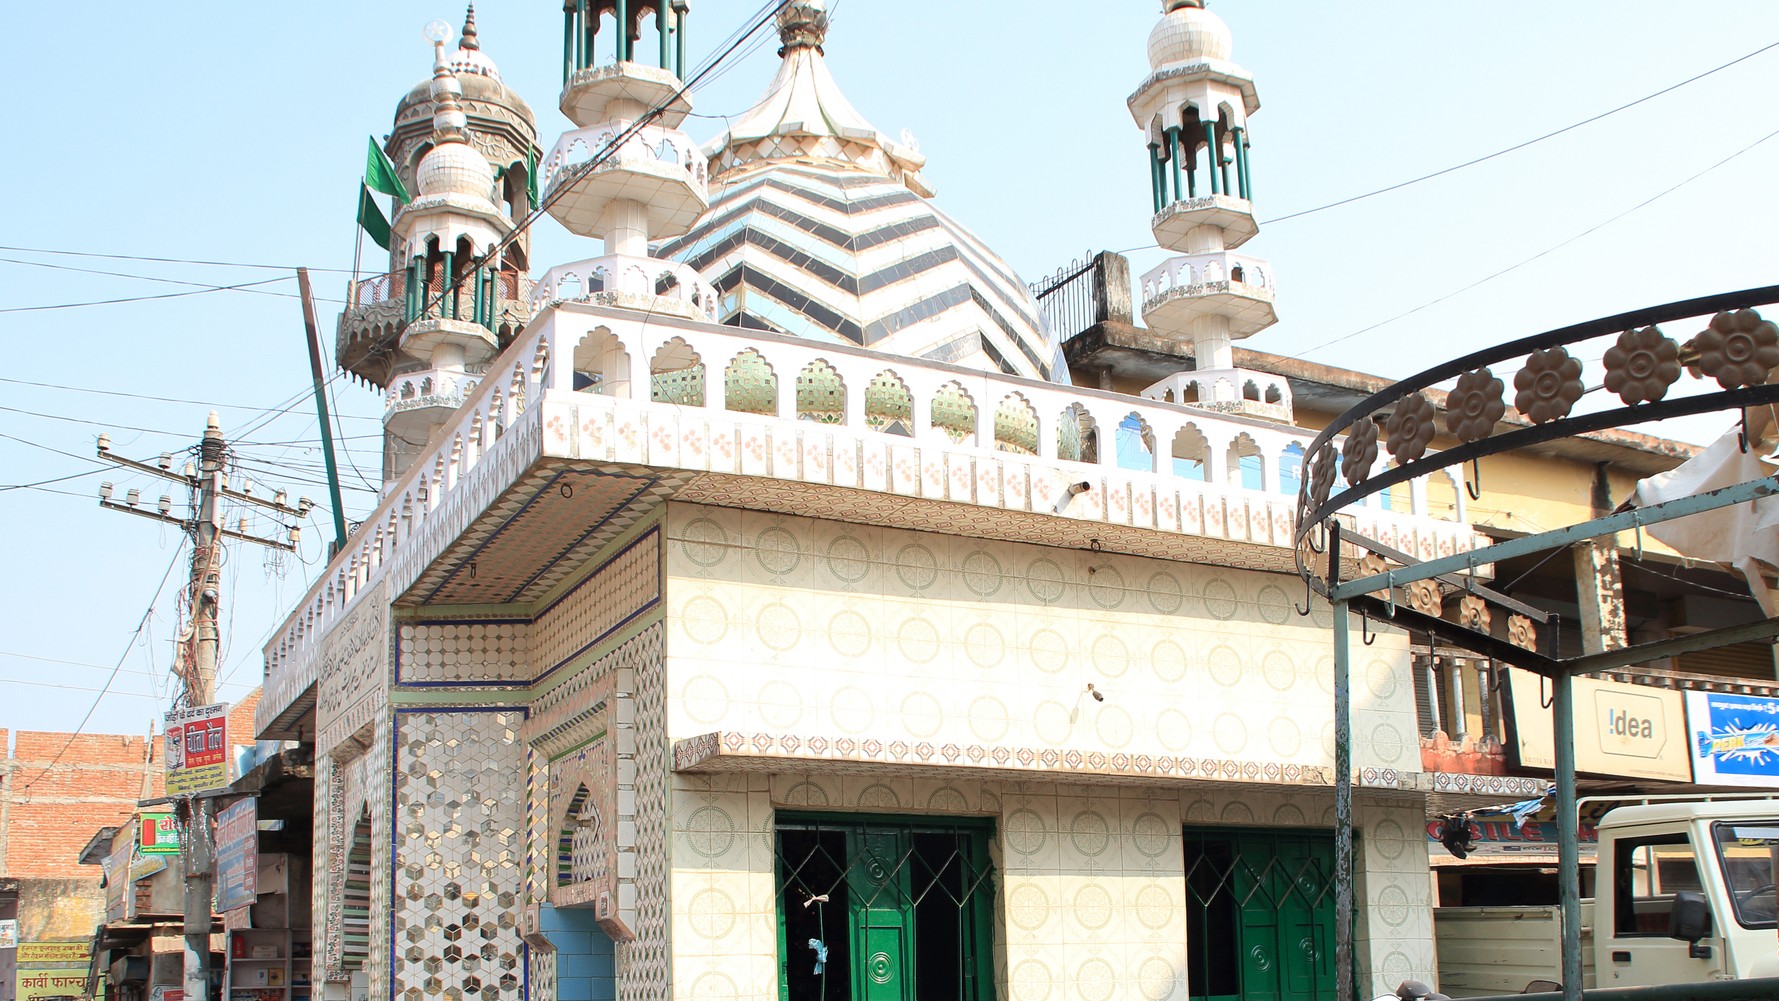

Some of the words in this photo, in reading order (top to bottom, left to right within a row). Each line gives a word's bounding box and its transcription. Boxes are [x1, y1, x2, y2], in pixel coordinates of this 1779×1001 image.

[196, 708, 204, 716] का
[186, 725, 206, 754] चीता
[1711, 735, 1745, 752] PERK
